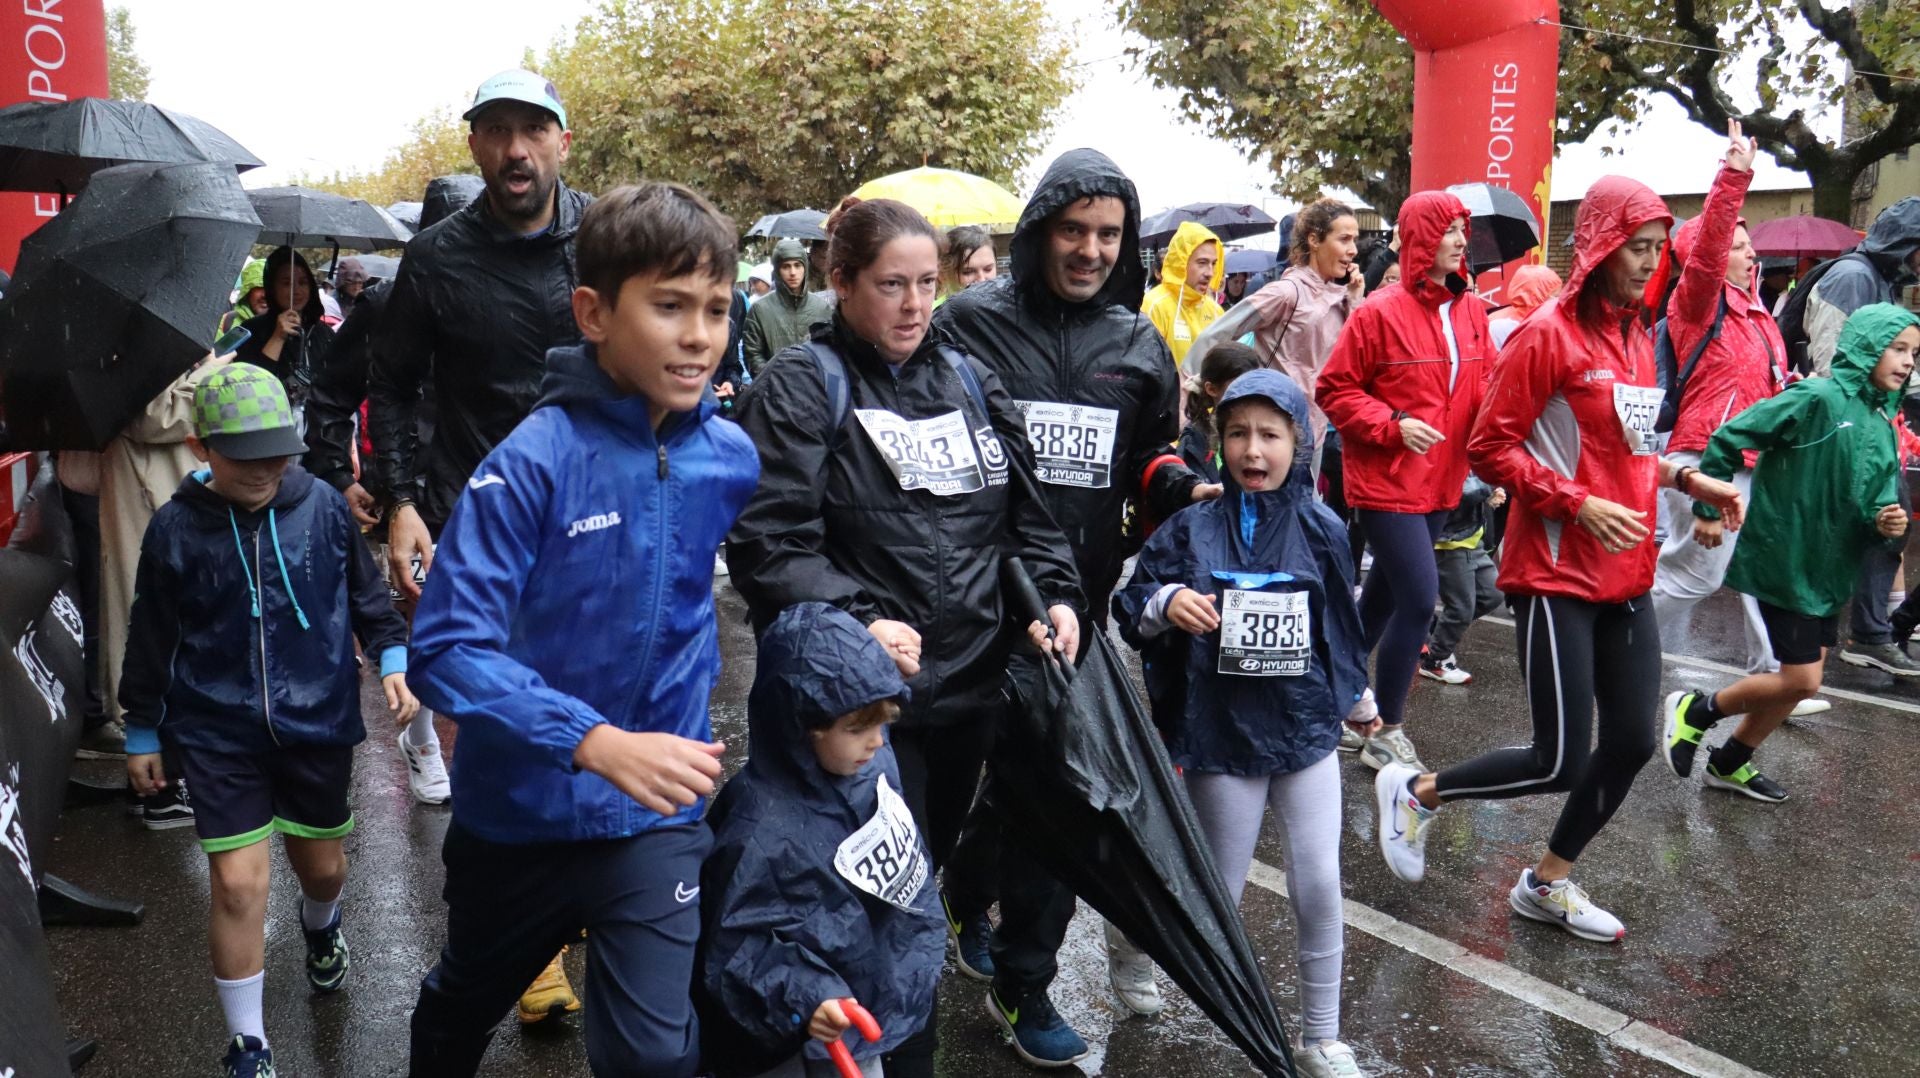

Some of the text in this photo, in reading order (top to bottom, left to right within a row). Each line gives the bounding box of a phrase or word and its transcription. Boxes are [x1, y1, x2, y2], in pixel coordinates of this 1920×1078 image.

[1487, 62, 1518, 190] PORTES
[880, 430, 955, 470] 3843
[1030, 422, 1098, 460] 3836
[1050, 469, 1094, 482] HYUNDAI
[568, 511, 621, 537] Joma
[1241, 613, 1304, 648] 3839
[854, 812, 913, 895] 3844
